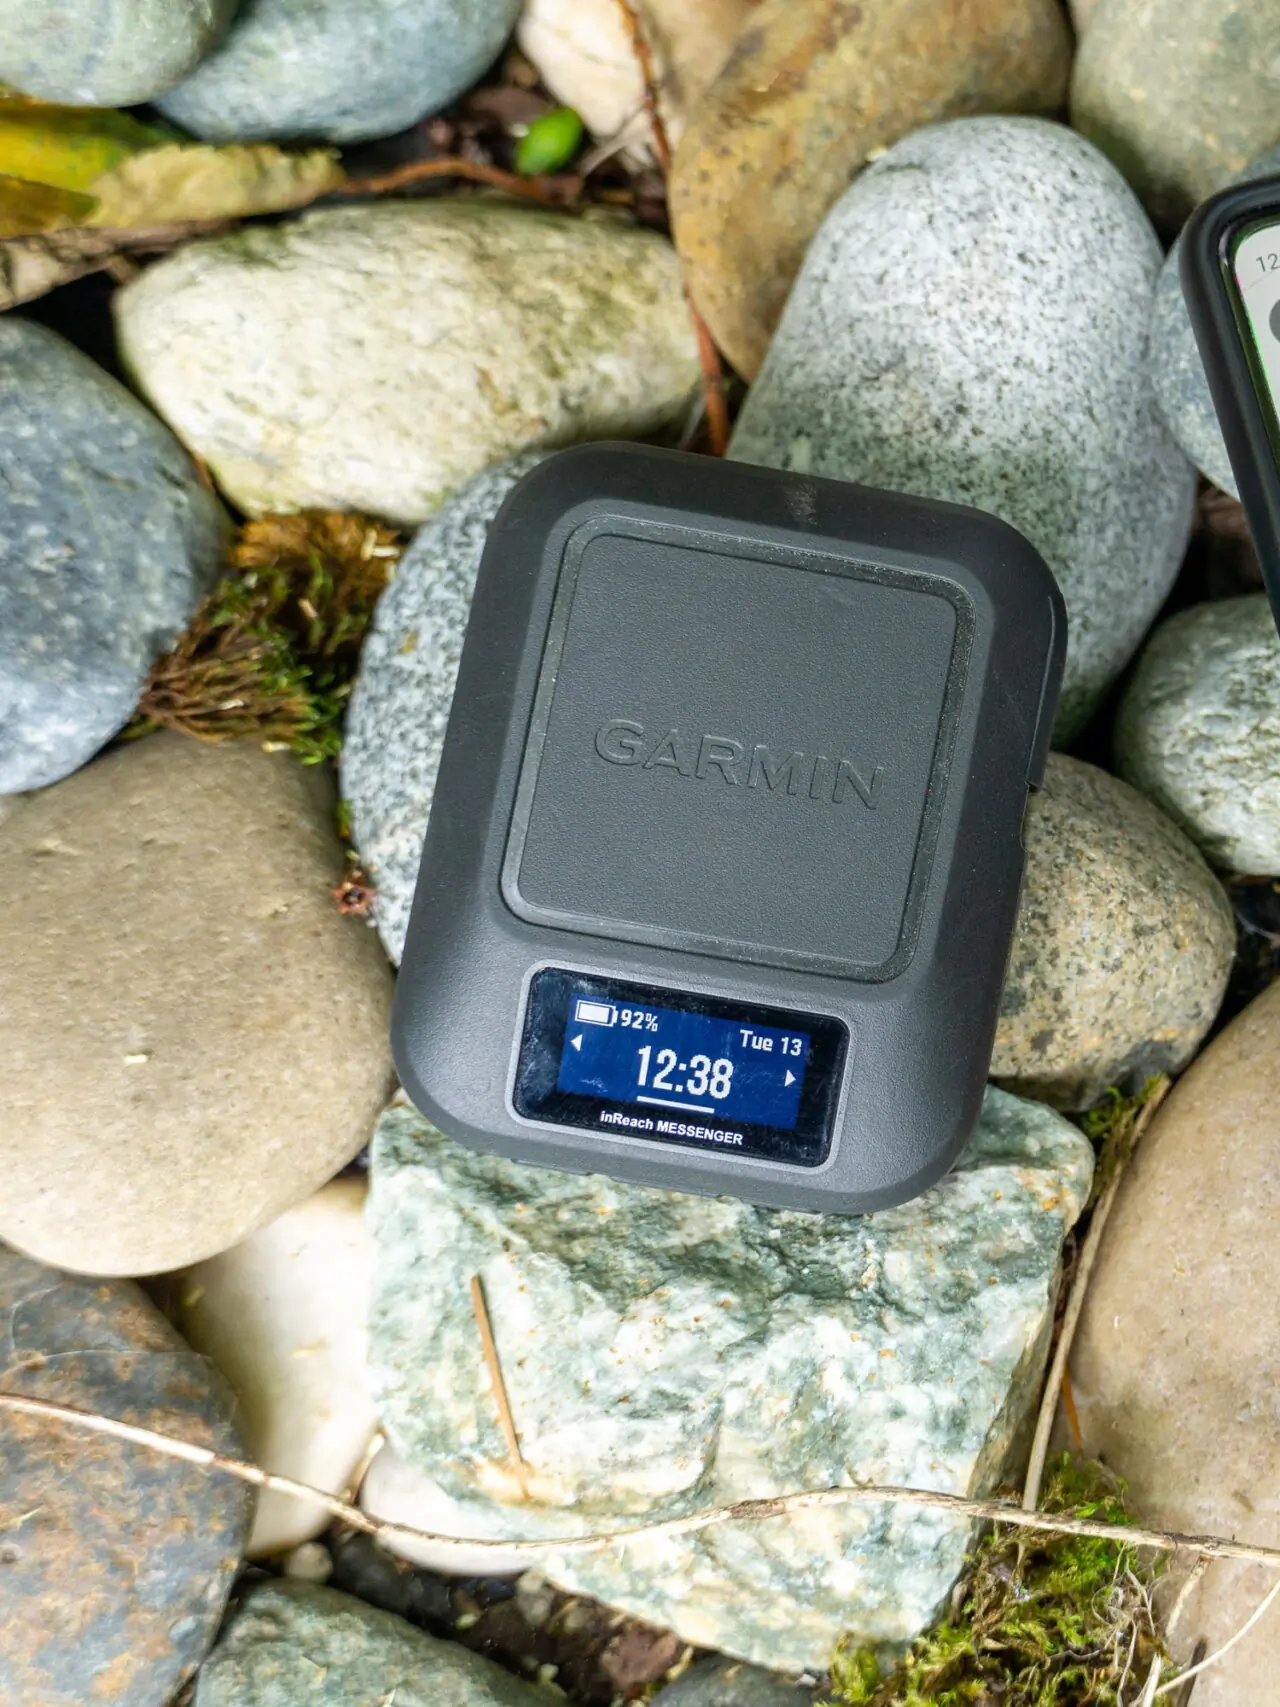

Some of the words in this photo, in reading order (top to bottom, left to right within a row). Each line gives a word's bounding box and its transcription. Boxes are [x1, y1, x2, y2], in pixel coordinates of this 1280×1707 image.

[594, 718, 885, 811] GARMIN
[621, 1009, 658, 1032] 92%
[740, 1029, 772, 1052] Tue
[780, 1037, 802, 1057] 13
[637, 1045, 734, 1099] 12:38
[600, 1110, 653, 1131] inReach
[656, 1120, 744, 1145] MESSENGER
